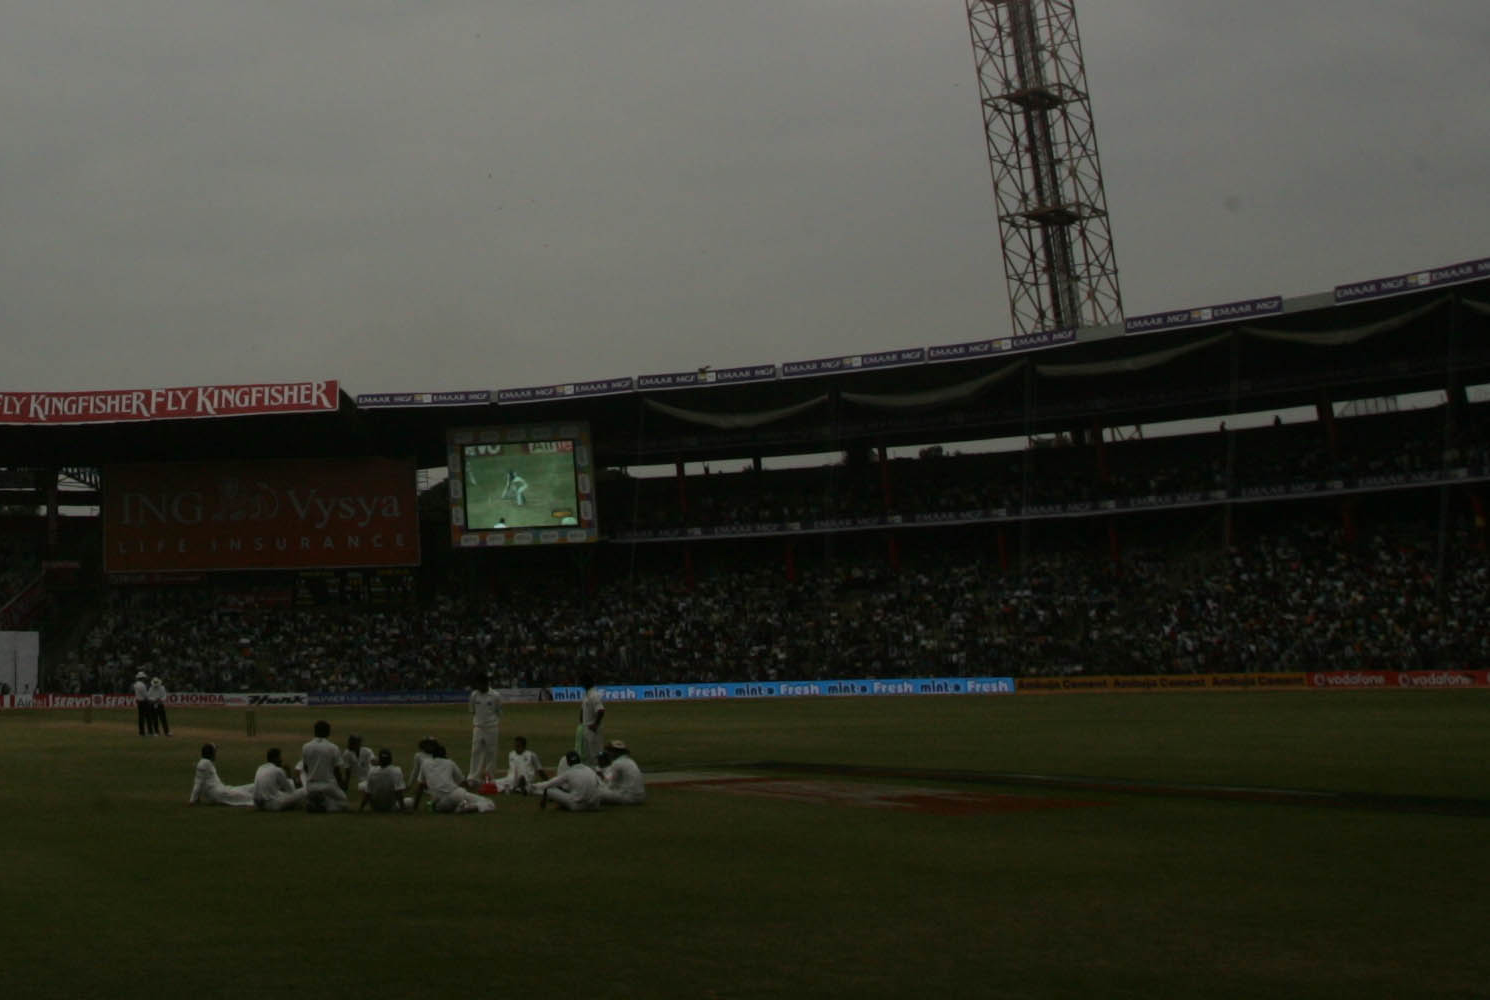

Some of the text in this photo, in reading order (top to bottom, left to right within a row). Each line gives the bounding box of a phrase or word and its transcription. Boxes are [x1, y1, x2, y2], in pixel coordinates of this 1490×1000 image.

[149, 380, 333, 416] FLY KINGFISHER
[29, 390, 151, 421] KINGFISHER
[120, 488, 402, 528] ING Vysya
[118, 533, 407, 553] LIFE INSURANCE
[967, 679, 1008, 691] Fresh
[1327, 673, 1385, 686] vodafone
[688, 685, 727, 697] Fresh
[780, 683, 819, 695] Fresh
[874, 681, 913, 693] Fresh
[53, 695, 91, 706] SERVO
[181, 694, 225, 704] HONDA
